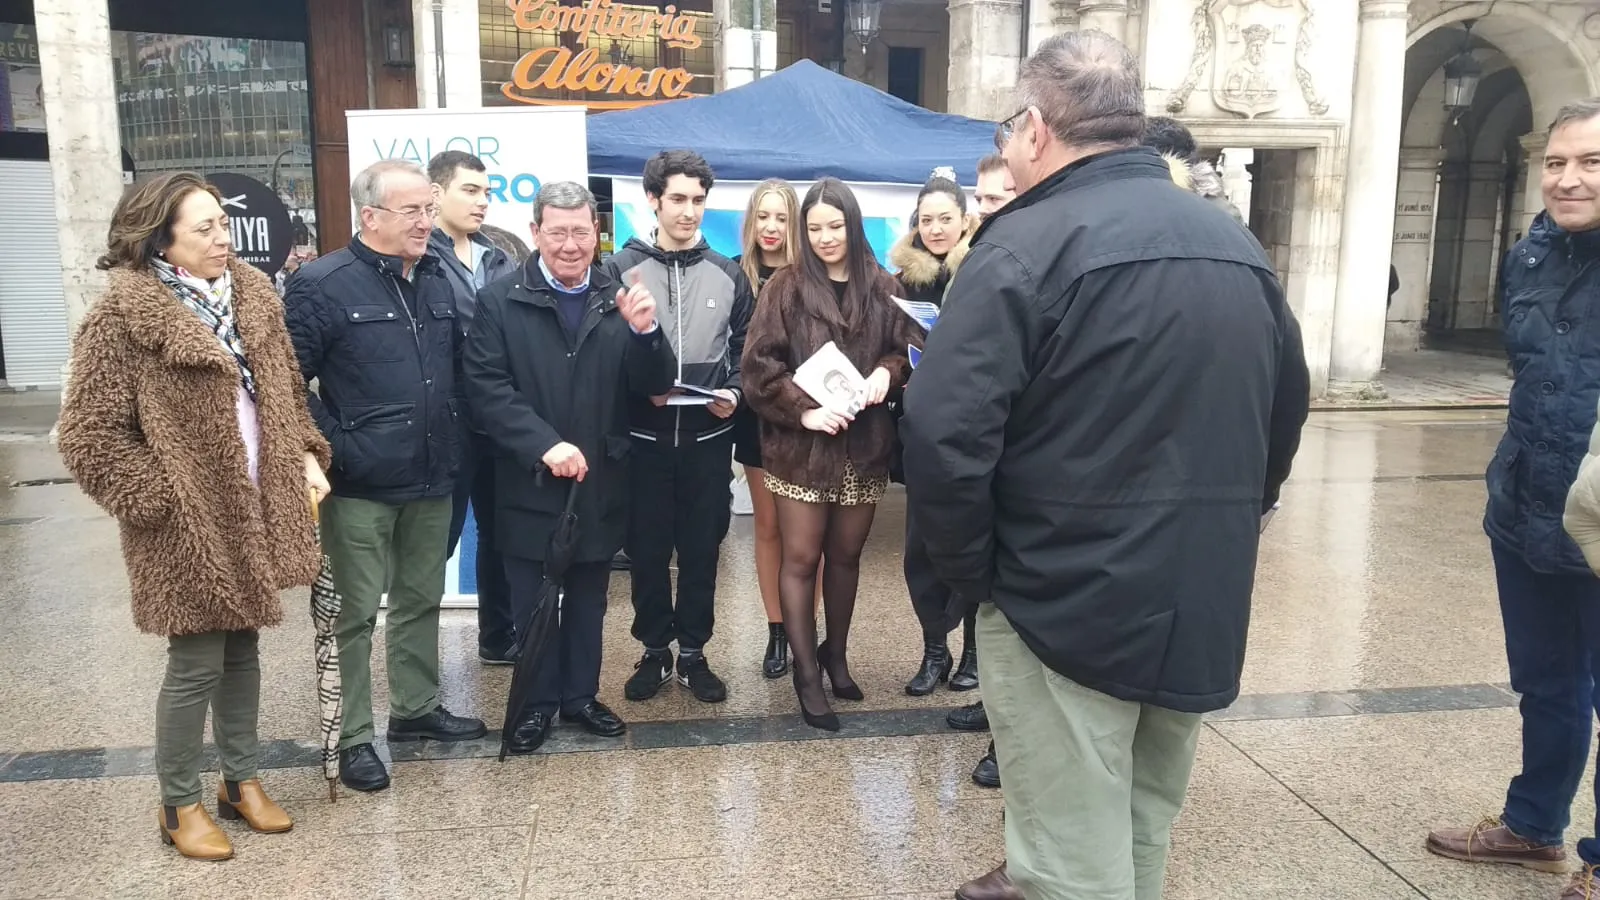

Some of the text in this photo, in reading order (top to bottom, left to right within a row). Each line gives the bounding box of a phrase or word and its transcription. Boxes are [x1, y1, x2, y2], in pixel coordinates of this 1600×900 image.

[509, 46, 695, 98] Alonso
[486, 173, 542, 203] RO
[229, 216, 270, 252] UYA
